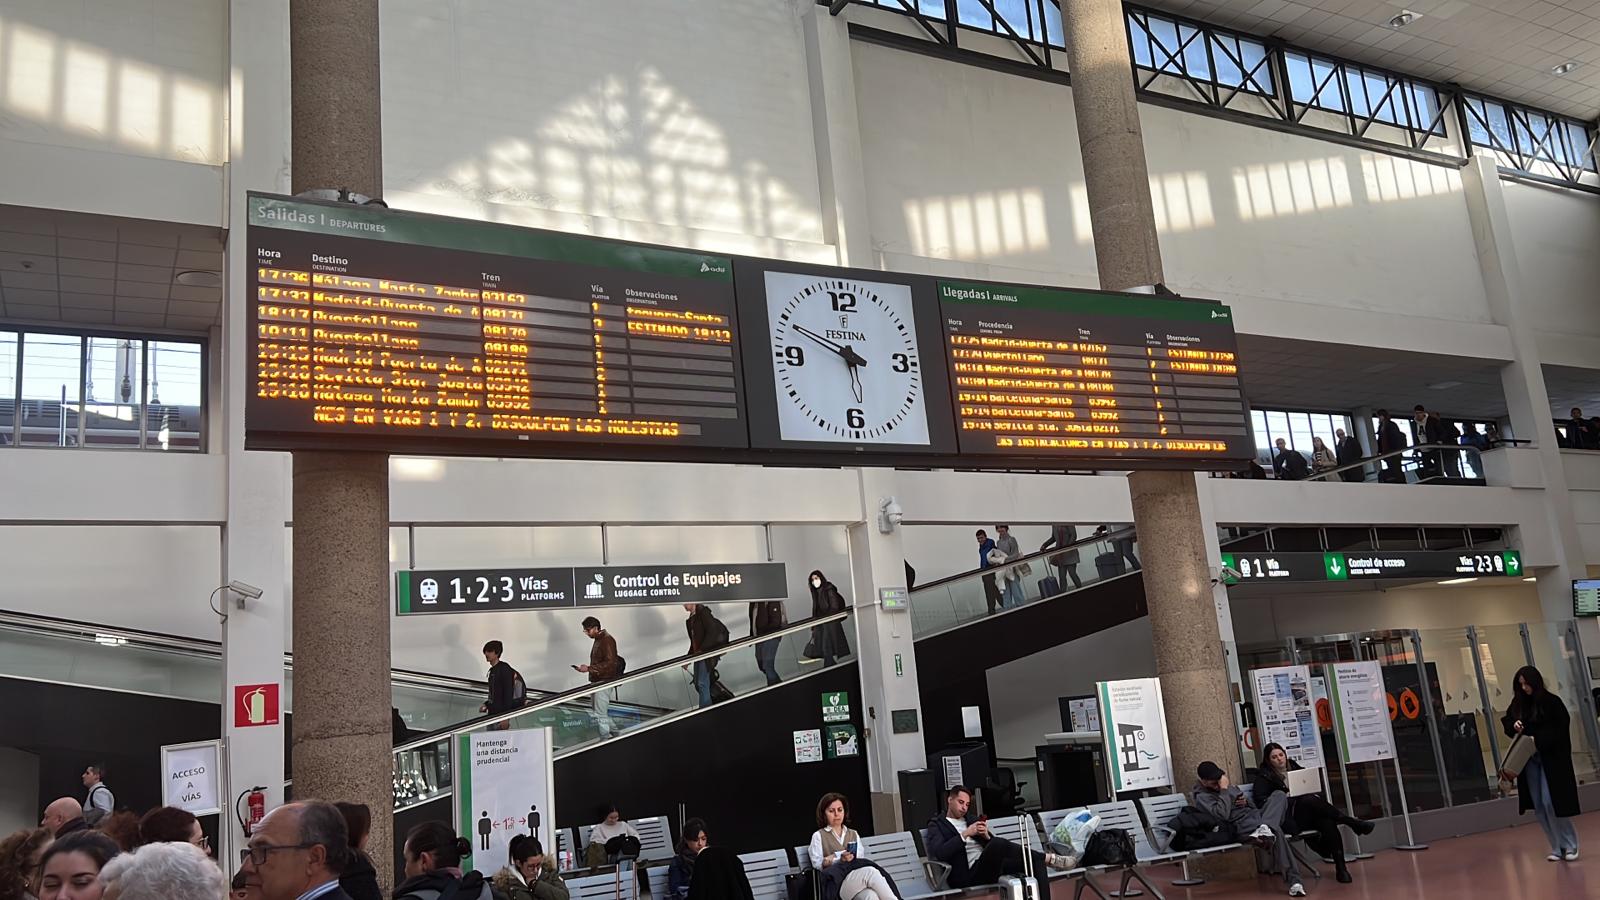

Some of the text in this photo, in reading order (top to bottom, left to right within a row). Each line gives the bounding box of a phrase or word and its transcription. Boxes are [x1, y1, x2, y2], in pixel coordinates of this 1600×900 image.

[257, 207, 387, 233] Salidas DEPARTURES
[258, 248, 281, 259] Hora
[312, 254, 348, 266] Destino
[312, 264, 347, 272] DESTINATION
[481, 272, 501, 282] Tren
[591, 284, 604, 293] Vía
[625, 288, 679, 301] Observaciones
[943, 286, 1018, 303] Llegadas ARRIVALS
[827, 291, 858, 313] 12
[948, 318, 963, 326] Hora
[978, 320, 1014, 330] Procedencia
[826, 329, 866, 342] FESTINA
[1078, 328, 1091, 336] Tren
[785, 346, 805, 367] 9
[892, 353, 910, 373] 3
[847, 408, 865, 429] 6
[1349, 557, 1405, 568] Control de acceso
[1459, 555, 1474, 567] Vías
[1253, 558, 1280, 577] 1 Vía
[519, 576, 549, 591] Vías
[614, 571, 742, 588] Control de Equipajes
[521, 592, 565, 601] PLATFORMS
[614, 588, 681, 598] LUGGAGE CONTROL
[476, 739, 507, 748] Mantenga
[491, 747, 518, 755] distancia
[477, 756, 510, 766] prudencial
[172, 766, 205, 780] ACCESO
[187, 781, 194, 789] A
[181, 792, 202, 803] VÍAS
